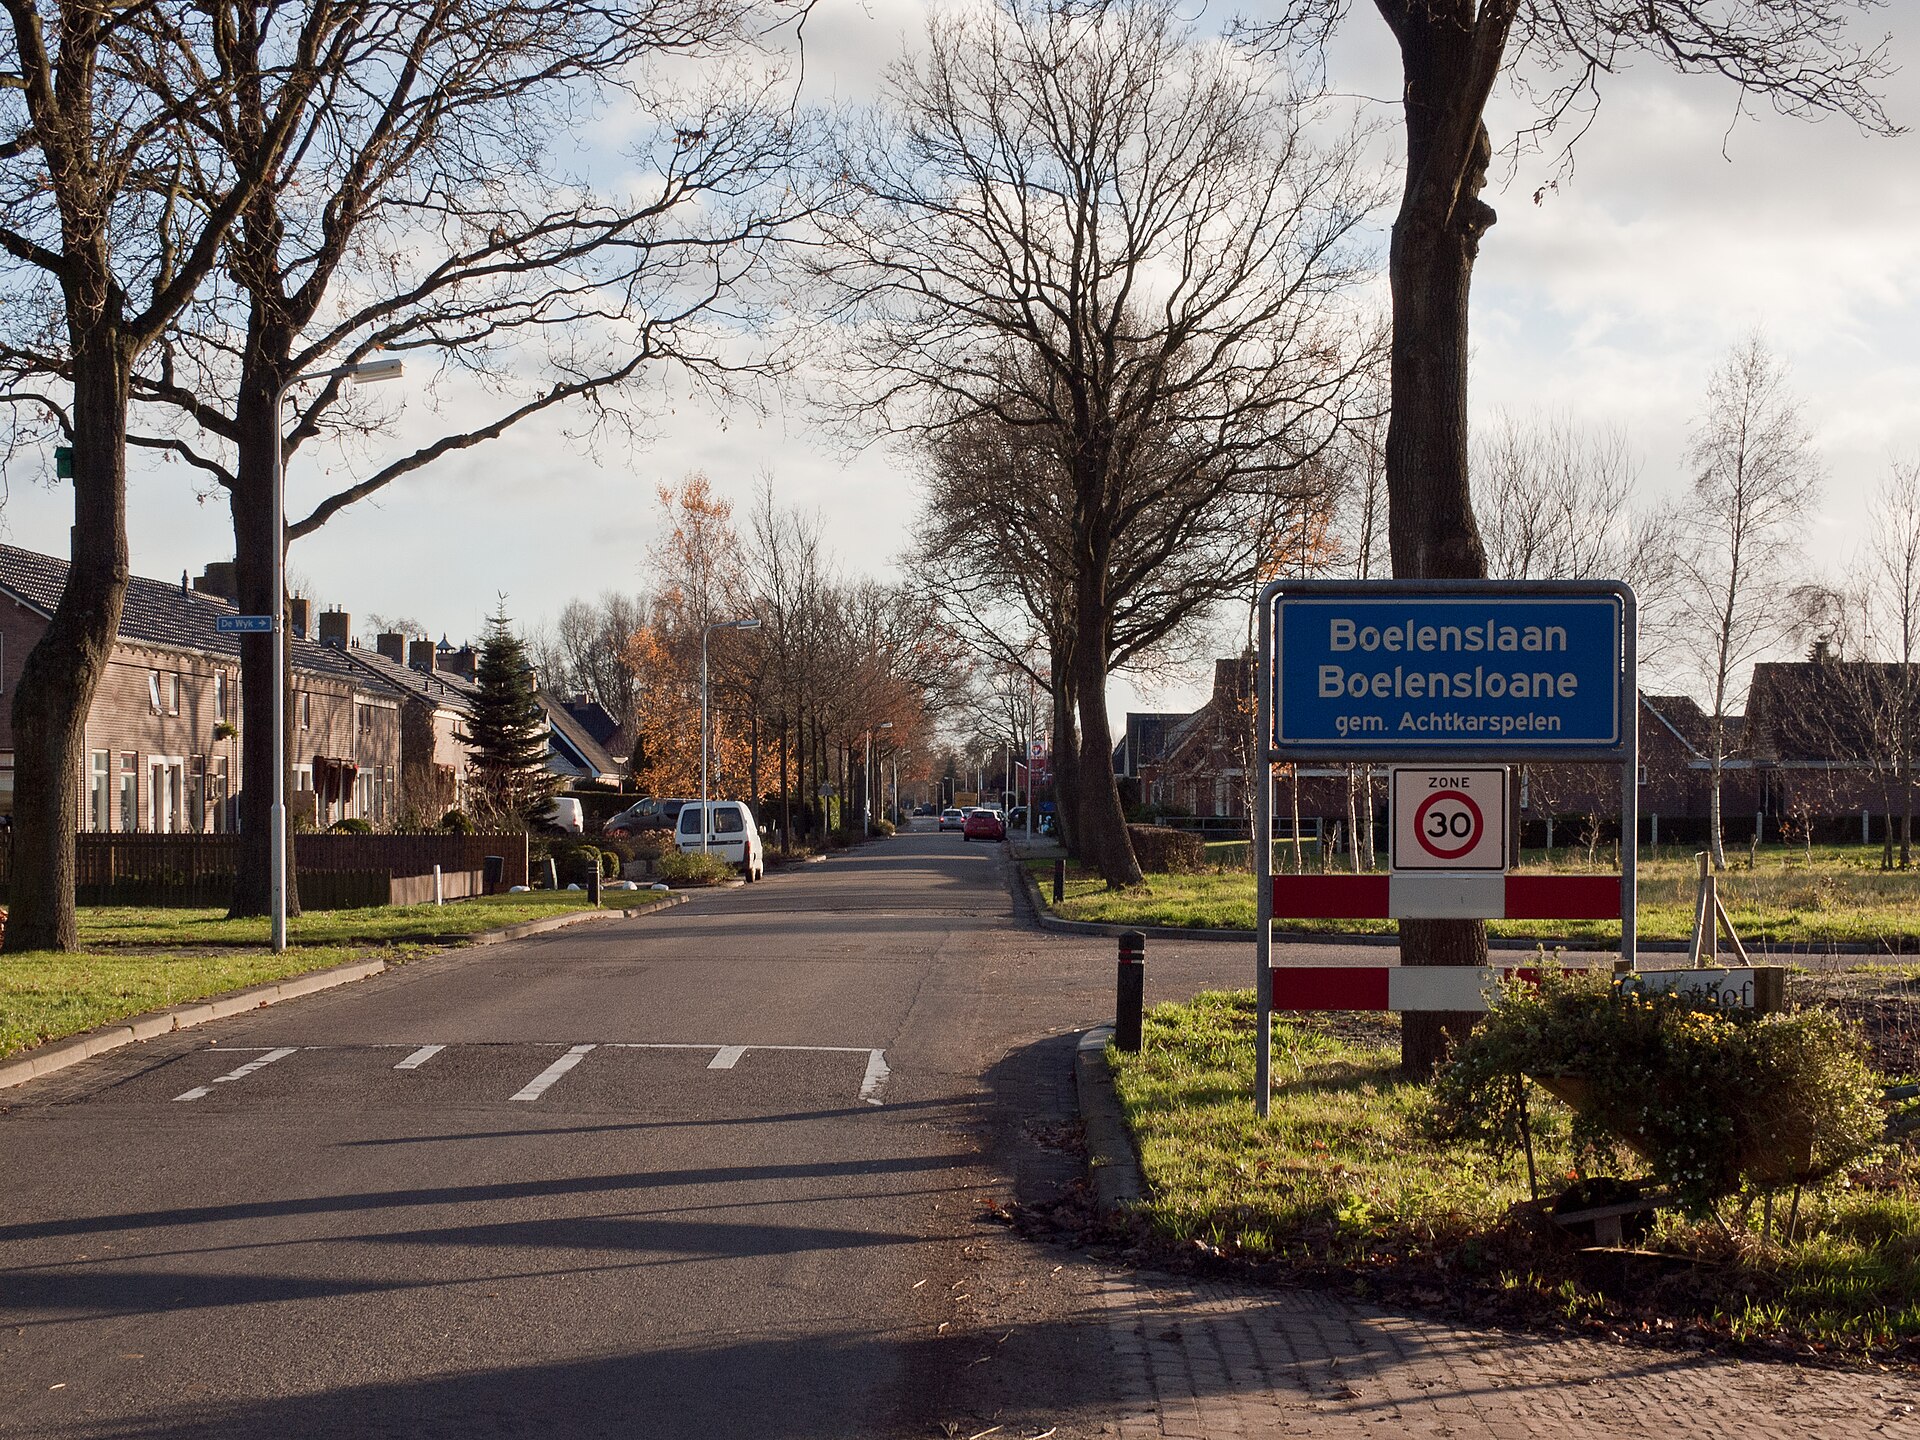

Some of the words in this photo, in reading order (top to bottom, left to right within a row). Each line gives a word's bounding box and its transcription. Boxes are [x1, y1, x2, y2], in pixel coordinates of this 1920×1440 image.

[221, 619, 233, 628] De
[235, 619, 254, 629] Wyk
[1329, 618, 1568, 652] Boelenslaan
[1318, 664, 1579, 699] Boelensloane
[1335, 713, 1389, 737] gem.
[1399, 711, 1562, 736] Achtkarspelen
[1428, 777, 1470, 788] ZONE
[1427, 811, 1472, 838] 30
